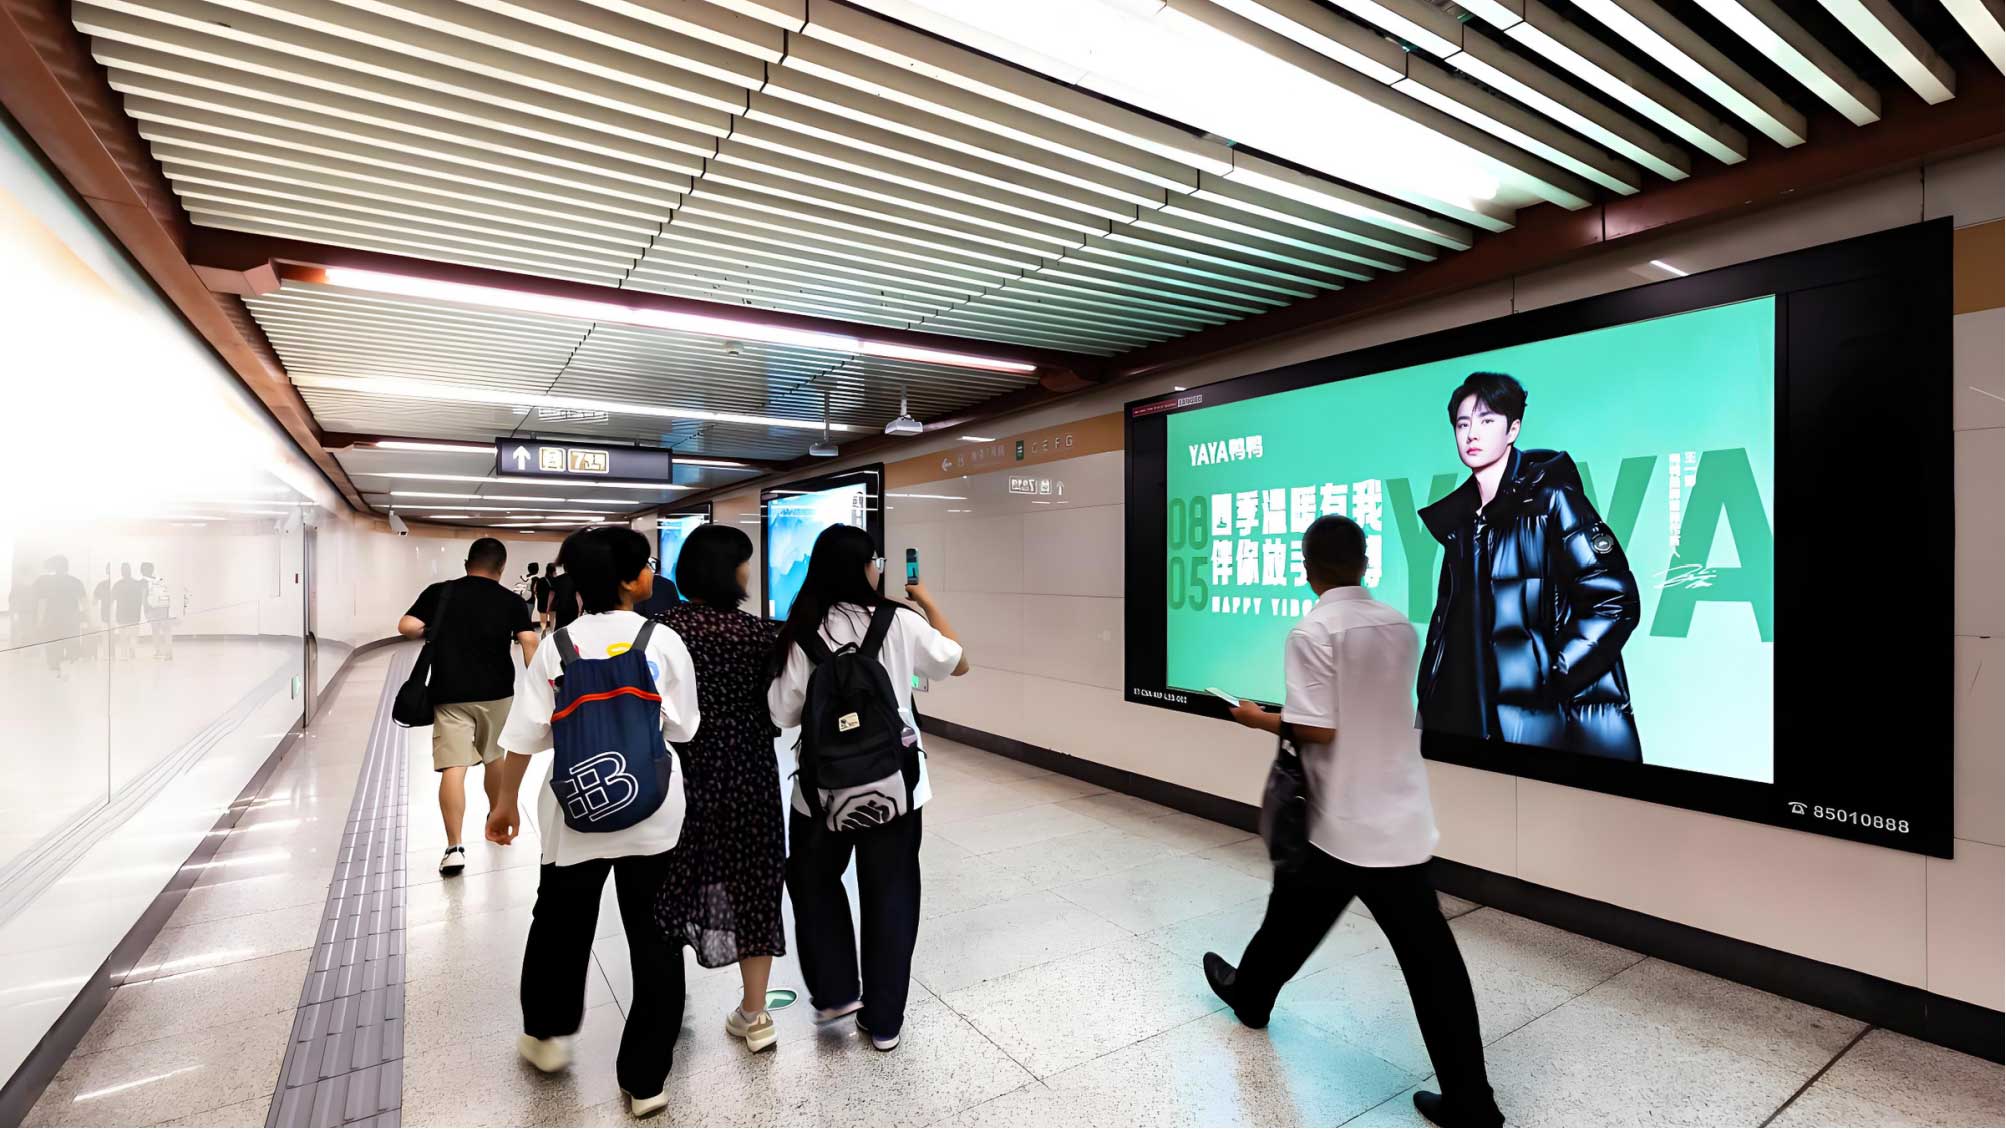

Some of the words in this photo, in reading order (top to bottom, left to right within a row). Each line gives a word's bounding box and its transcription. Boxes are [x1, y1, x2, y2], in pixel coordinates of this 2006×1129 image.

[1168, 495, 1209, 551] 08
[1168, 556, 1209, 612] 05
[1212, 596, 1262, 615] HAPPY
[1813, 805, 1910, 834] 85010888
